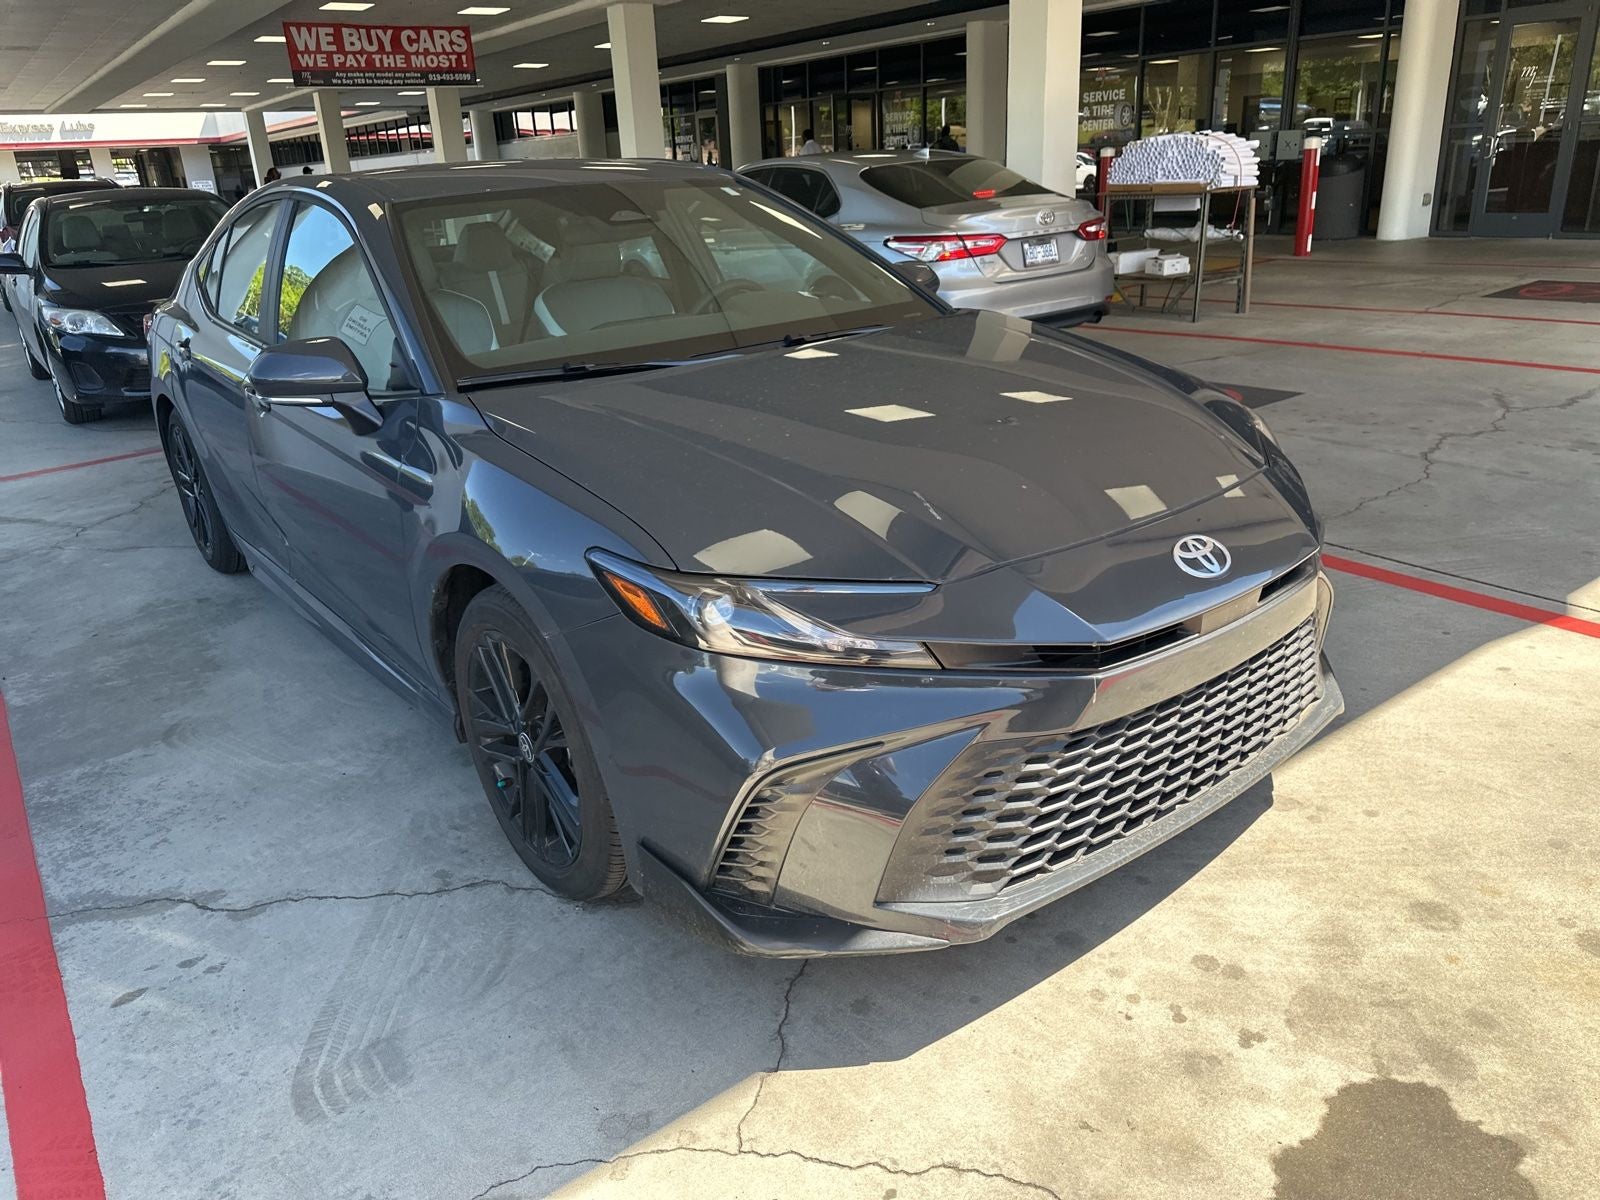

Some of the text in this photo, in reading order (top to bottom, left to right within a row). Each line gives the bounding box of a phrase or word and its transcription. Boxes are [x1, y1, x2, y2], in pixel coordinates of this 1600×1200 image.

[289, 26, 468, 53] WE BUY CARS
[297, 54, 329, 67] WE
[333, 54, 367, 67] PAY
[372, 54, 407, 68] THE
[411, 54, 458, 68] MOST
[1082, 88, 1126, 103] SERVICE
[885, 110, 914, 122] SERVICE
[1082, 104, 1114, 117] & TIRE
[0, 120, 95, 135] Express Lube
[1081, 118, 1114, 131] CENTER
[885, 135, 909, 146] CENTER
